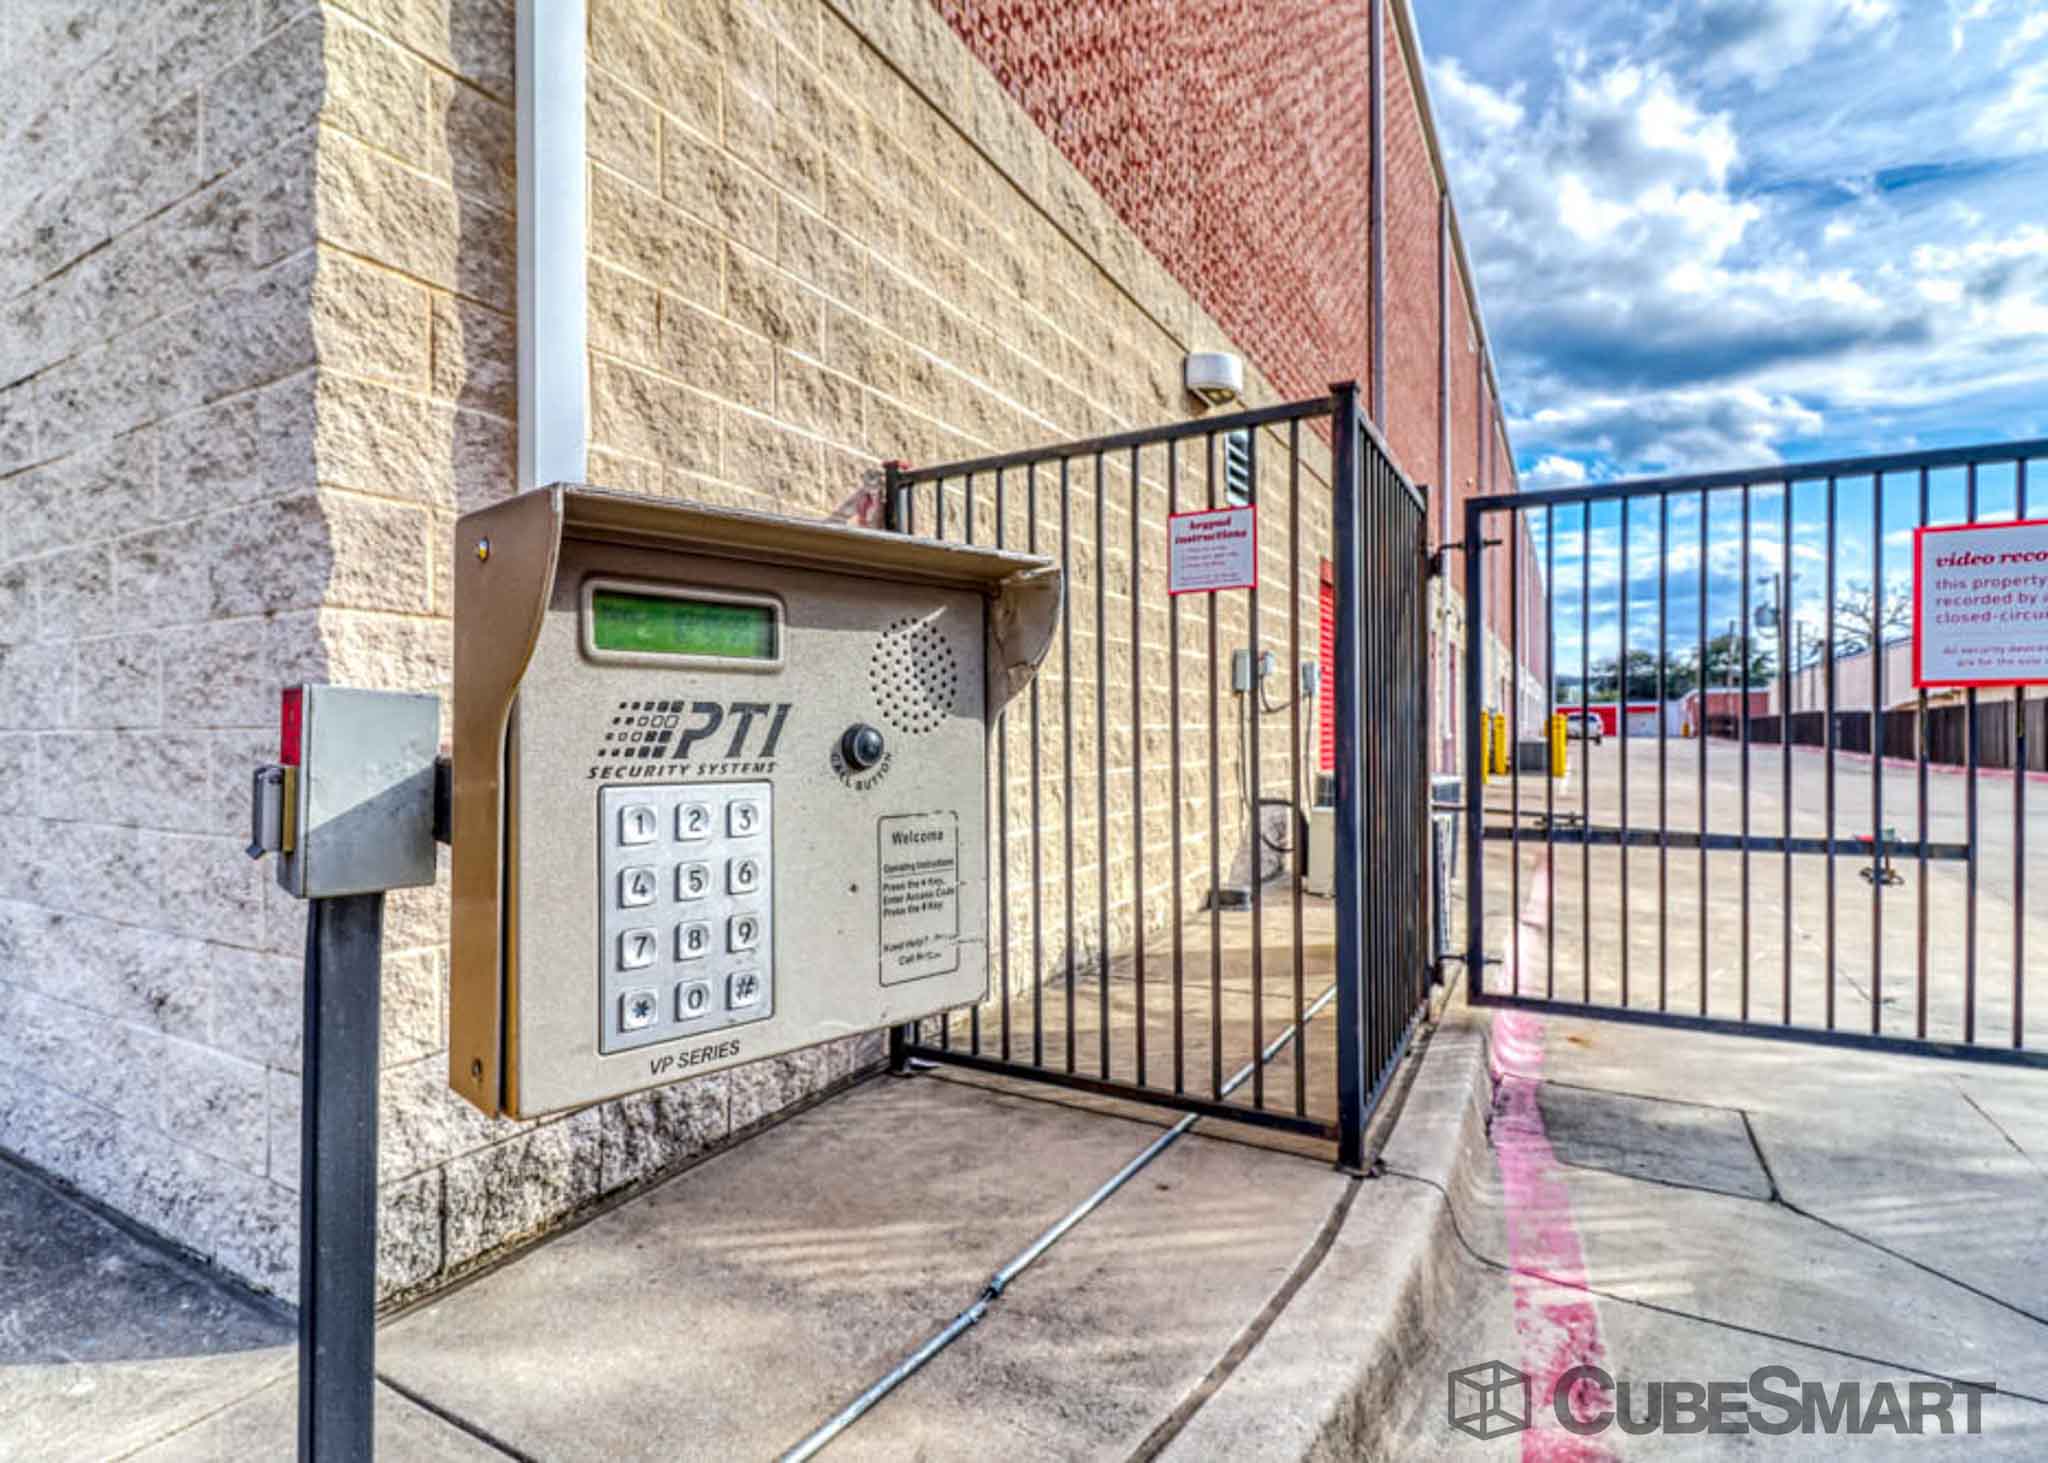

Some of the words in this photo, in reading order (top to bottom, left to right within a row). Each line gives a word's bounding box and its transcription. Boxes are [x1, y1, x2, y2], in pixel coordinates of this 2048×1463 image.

[1175, 530, 1247, 544] instructions
[1936, 551, 1995, 568] video
[1936, 578, 1967, 591] this
[1972, 574, 2048, 591] property
[1936, 592, 2012, 608] recorded
[2018, 591, 2037, 606] by
[671, 700, 793, 760] PTI
[587, 762, 690, 780] SECURITY
[697, 761, 777, 776] SYSTEMS
[688, 809, 702, 833] 2
[739, 808, 752, 831] 3
[892, 829, 944, 846] Welcome
[631, 873, 647, 899] 4
[688, 869, 703, 894] 5
[738, 861, 752, 886] 6
[883, 895, 905, 907] Enter
[633, 935, 648, 960] 7
[687, 928, 702, 952] 8
[738, 921, 752, 945] 9
[735, 974, 756, 1001] #
[650, 1054, 675, 1076] VP
[676, 1037, 741, 1069] SERIES
